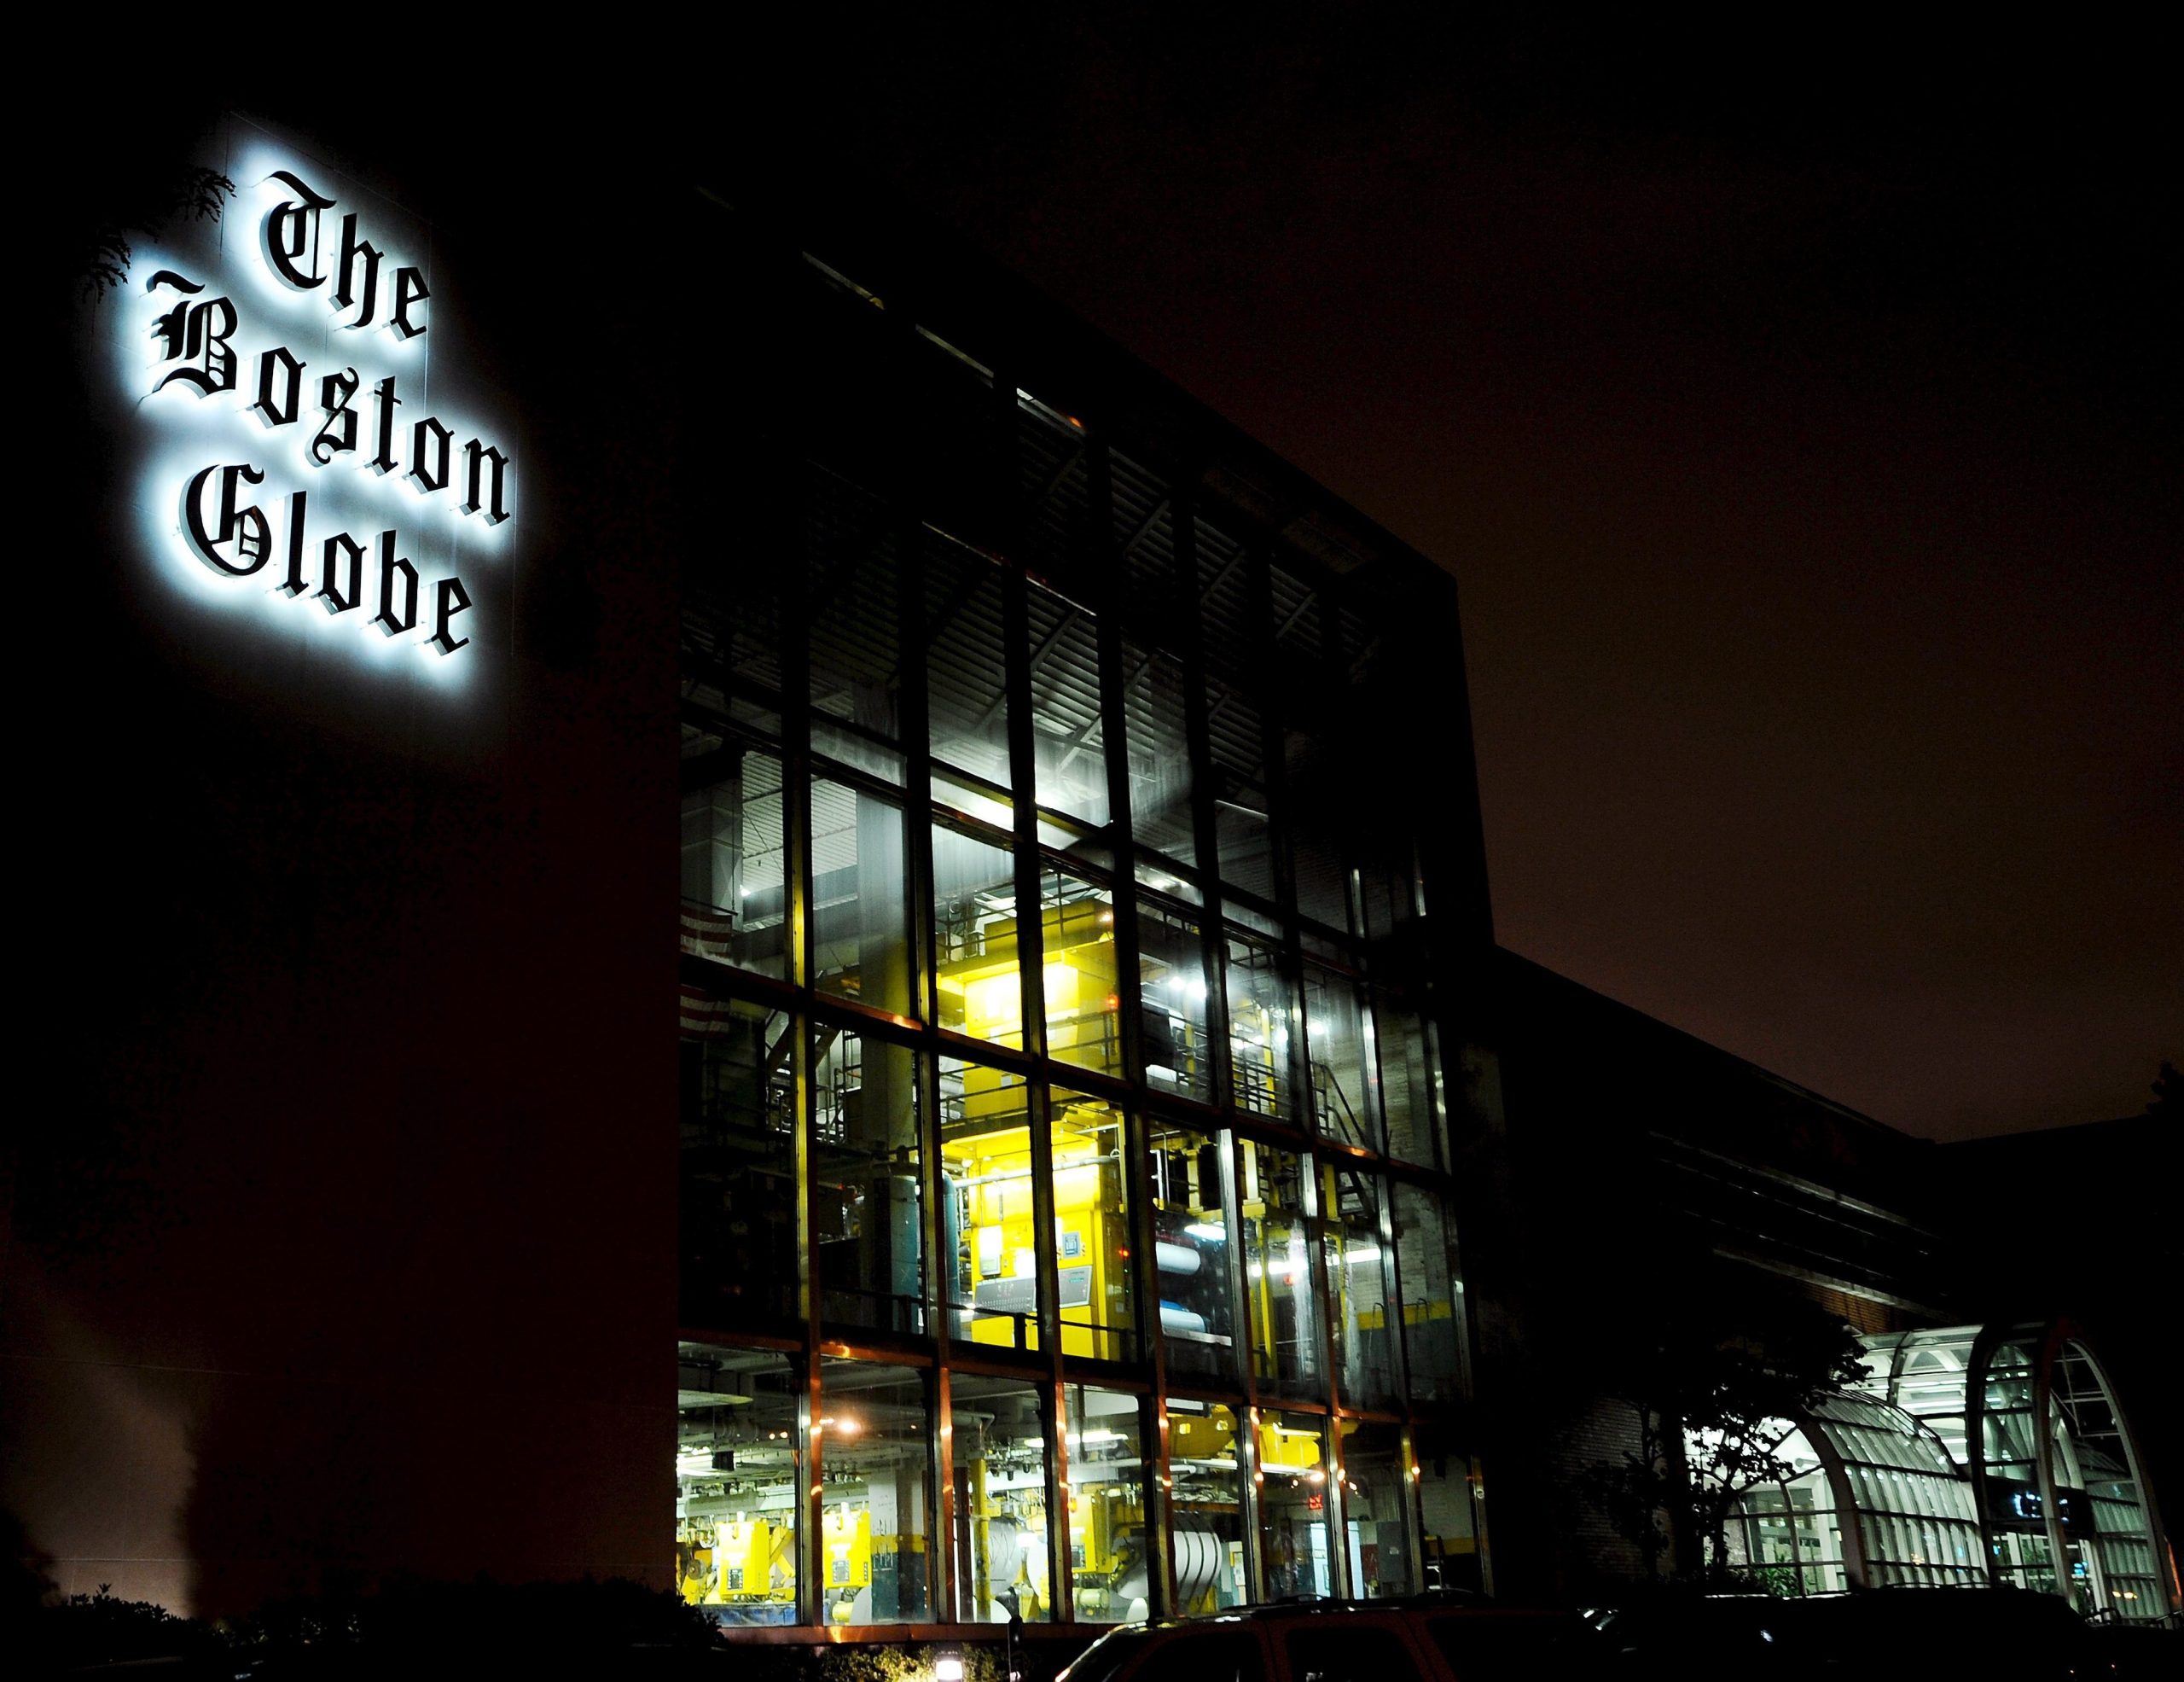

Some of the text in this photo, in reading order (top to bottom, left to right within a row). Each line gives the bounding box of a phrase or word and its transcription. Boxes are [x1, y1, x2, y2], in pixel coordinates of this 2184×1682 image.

[255, 170, 431, 341] The
[140, 270, 511, 526] Boston
[180, 463, 473, 655] Globe
